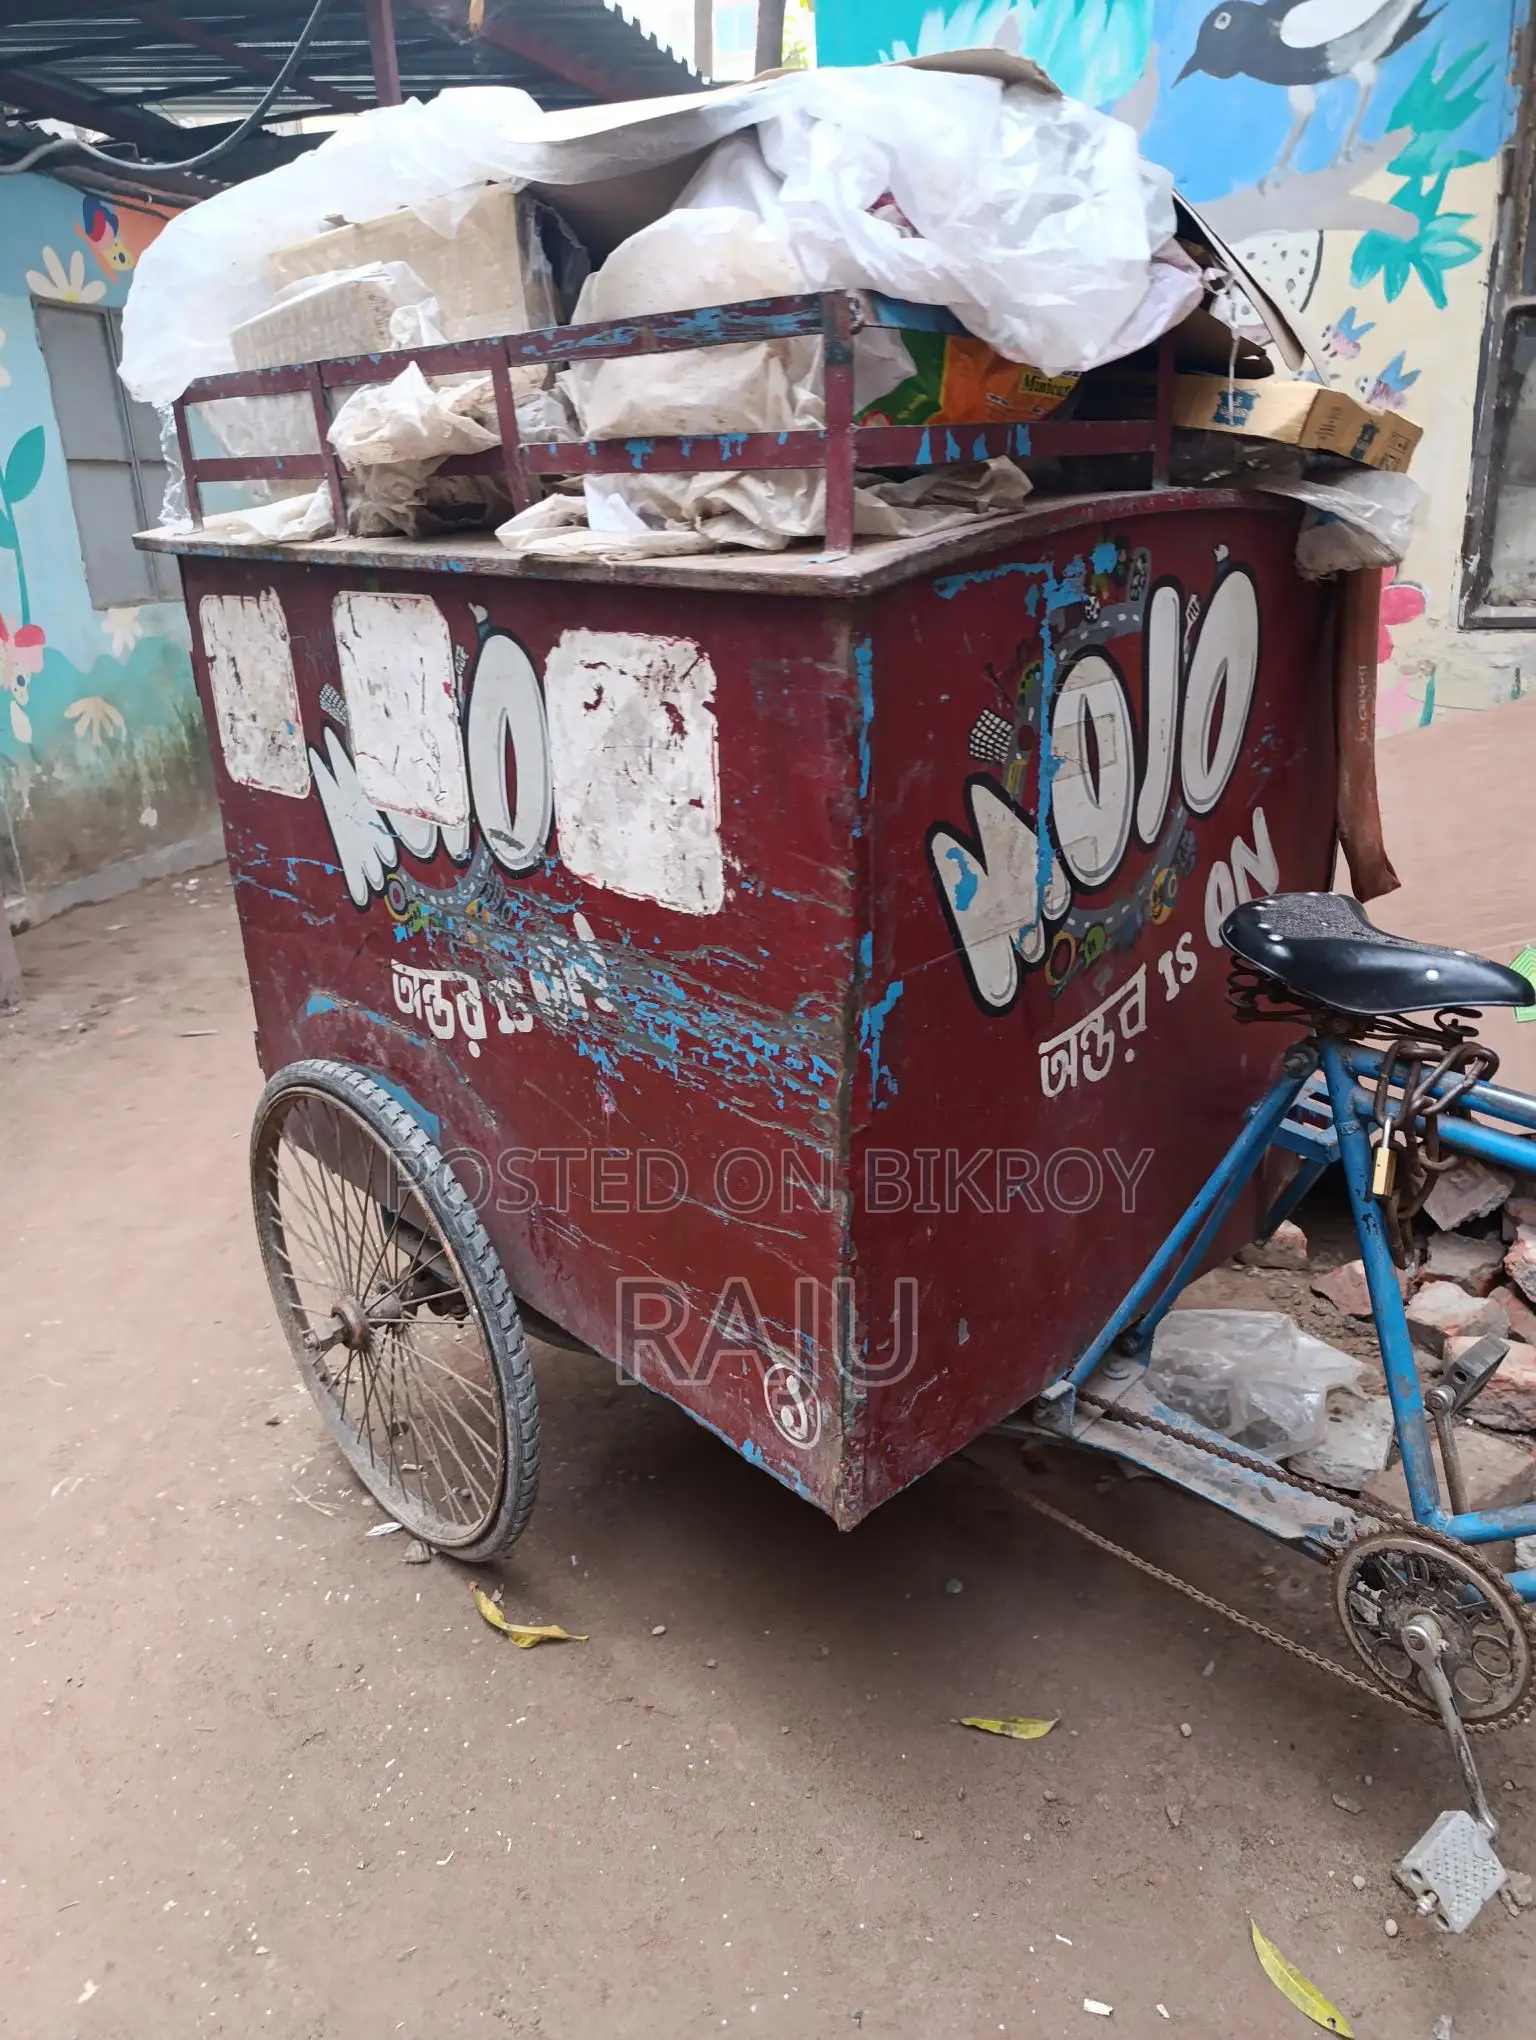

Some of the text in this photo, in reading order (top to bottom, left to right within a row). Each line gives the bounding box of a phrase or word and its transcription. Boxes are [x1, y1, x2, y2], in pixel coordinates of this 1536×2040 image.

[928, 566, 1257, 1012] MOJO
[1158, 931, 1198, 1002] IS
[1204, 806, 1279, 948] ON
